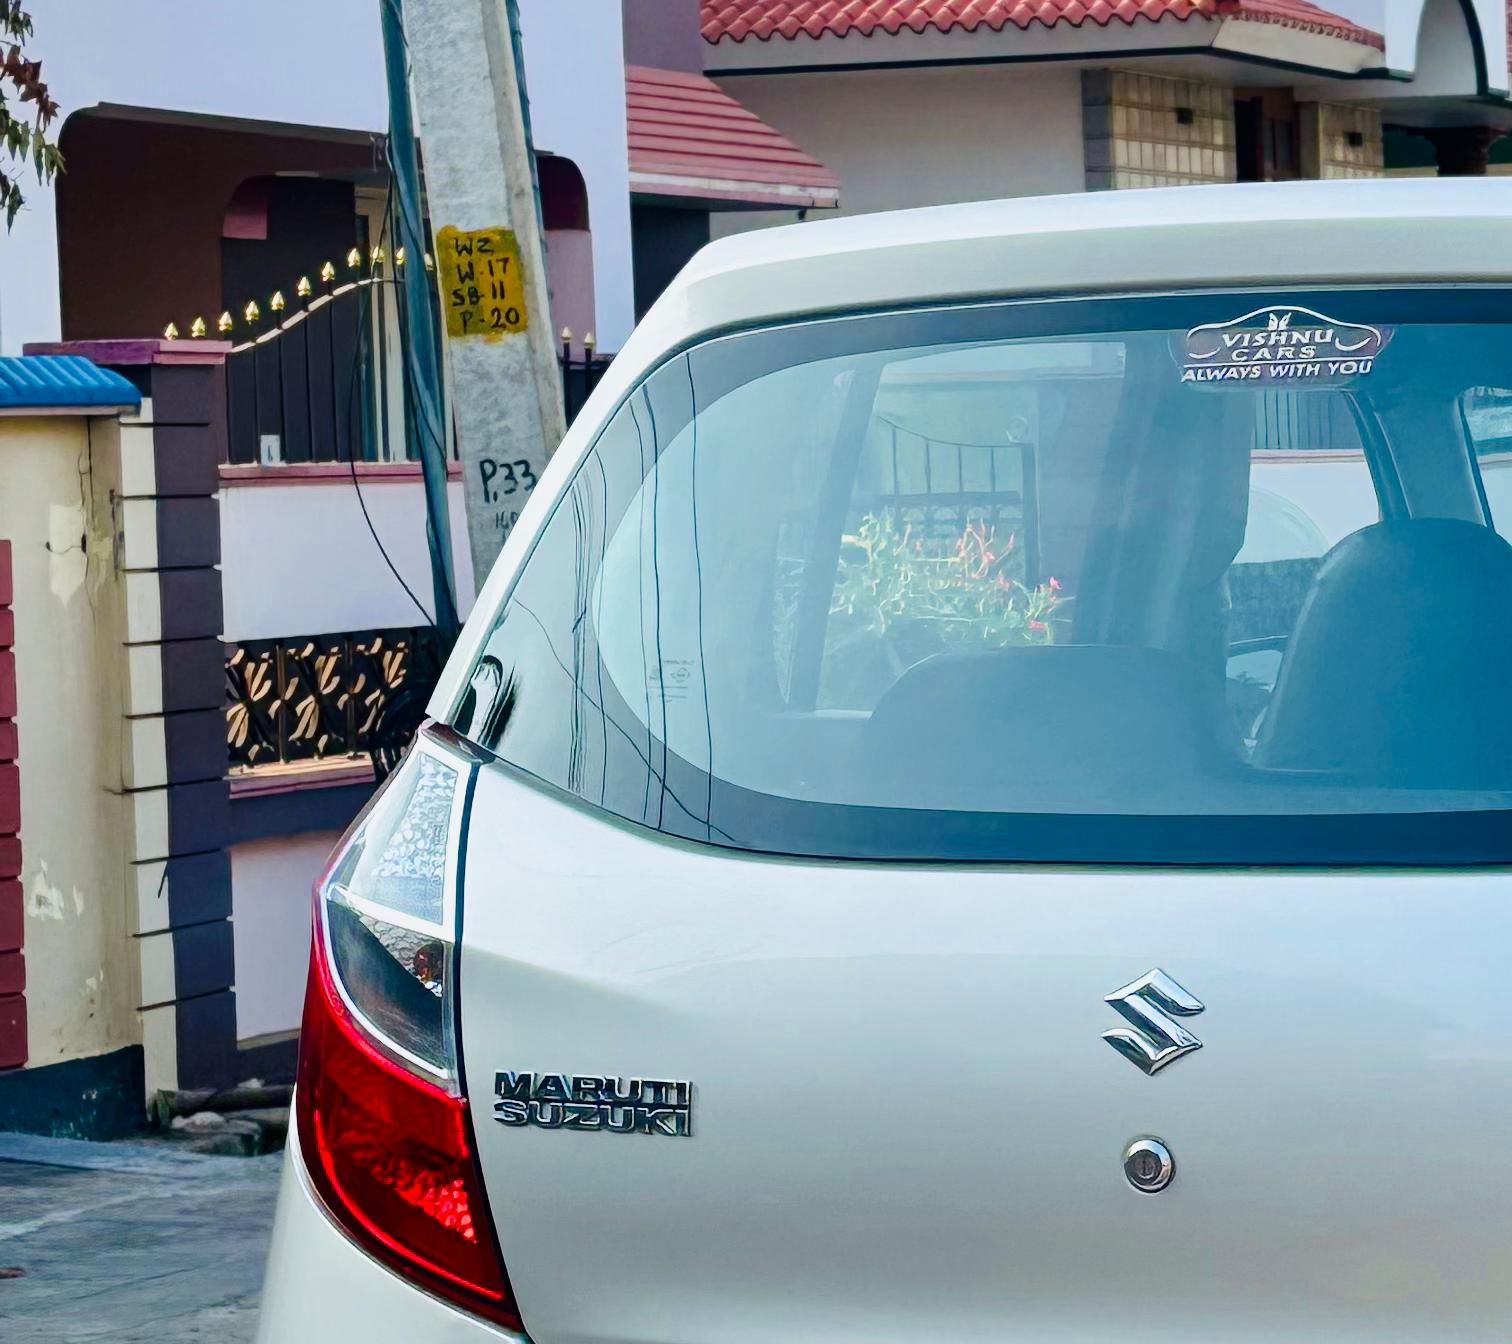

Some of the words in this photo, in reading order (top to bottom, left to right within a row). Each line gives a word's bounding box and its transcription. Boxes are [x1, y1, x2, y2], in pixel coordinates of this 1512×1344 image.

[1221, 329, 1334, 347] VISHNU
[1231, 345, 1317, 362] CARS
[1181, 365, 1262, 383] ALWAYS
[1269, 363, 1319, 378] WITH
[1328, 361, 1373, 375] YOU
[494, 1069, 692, 1106] MARUTI
[493, 1100, 692, 1137] SUZUKI
